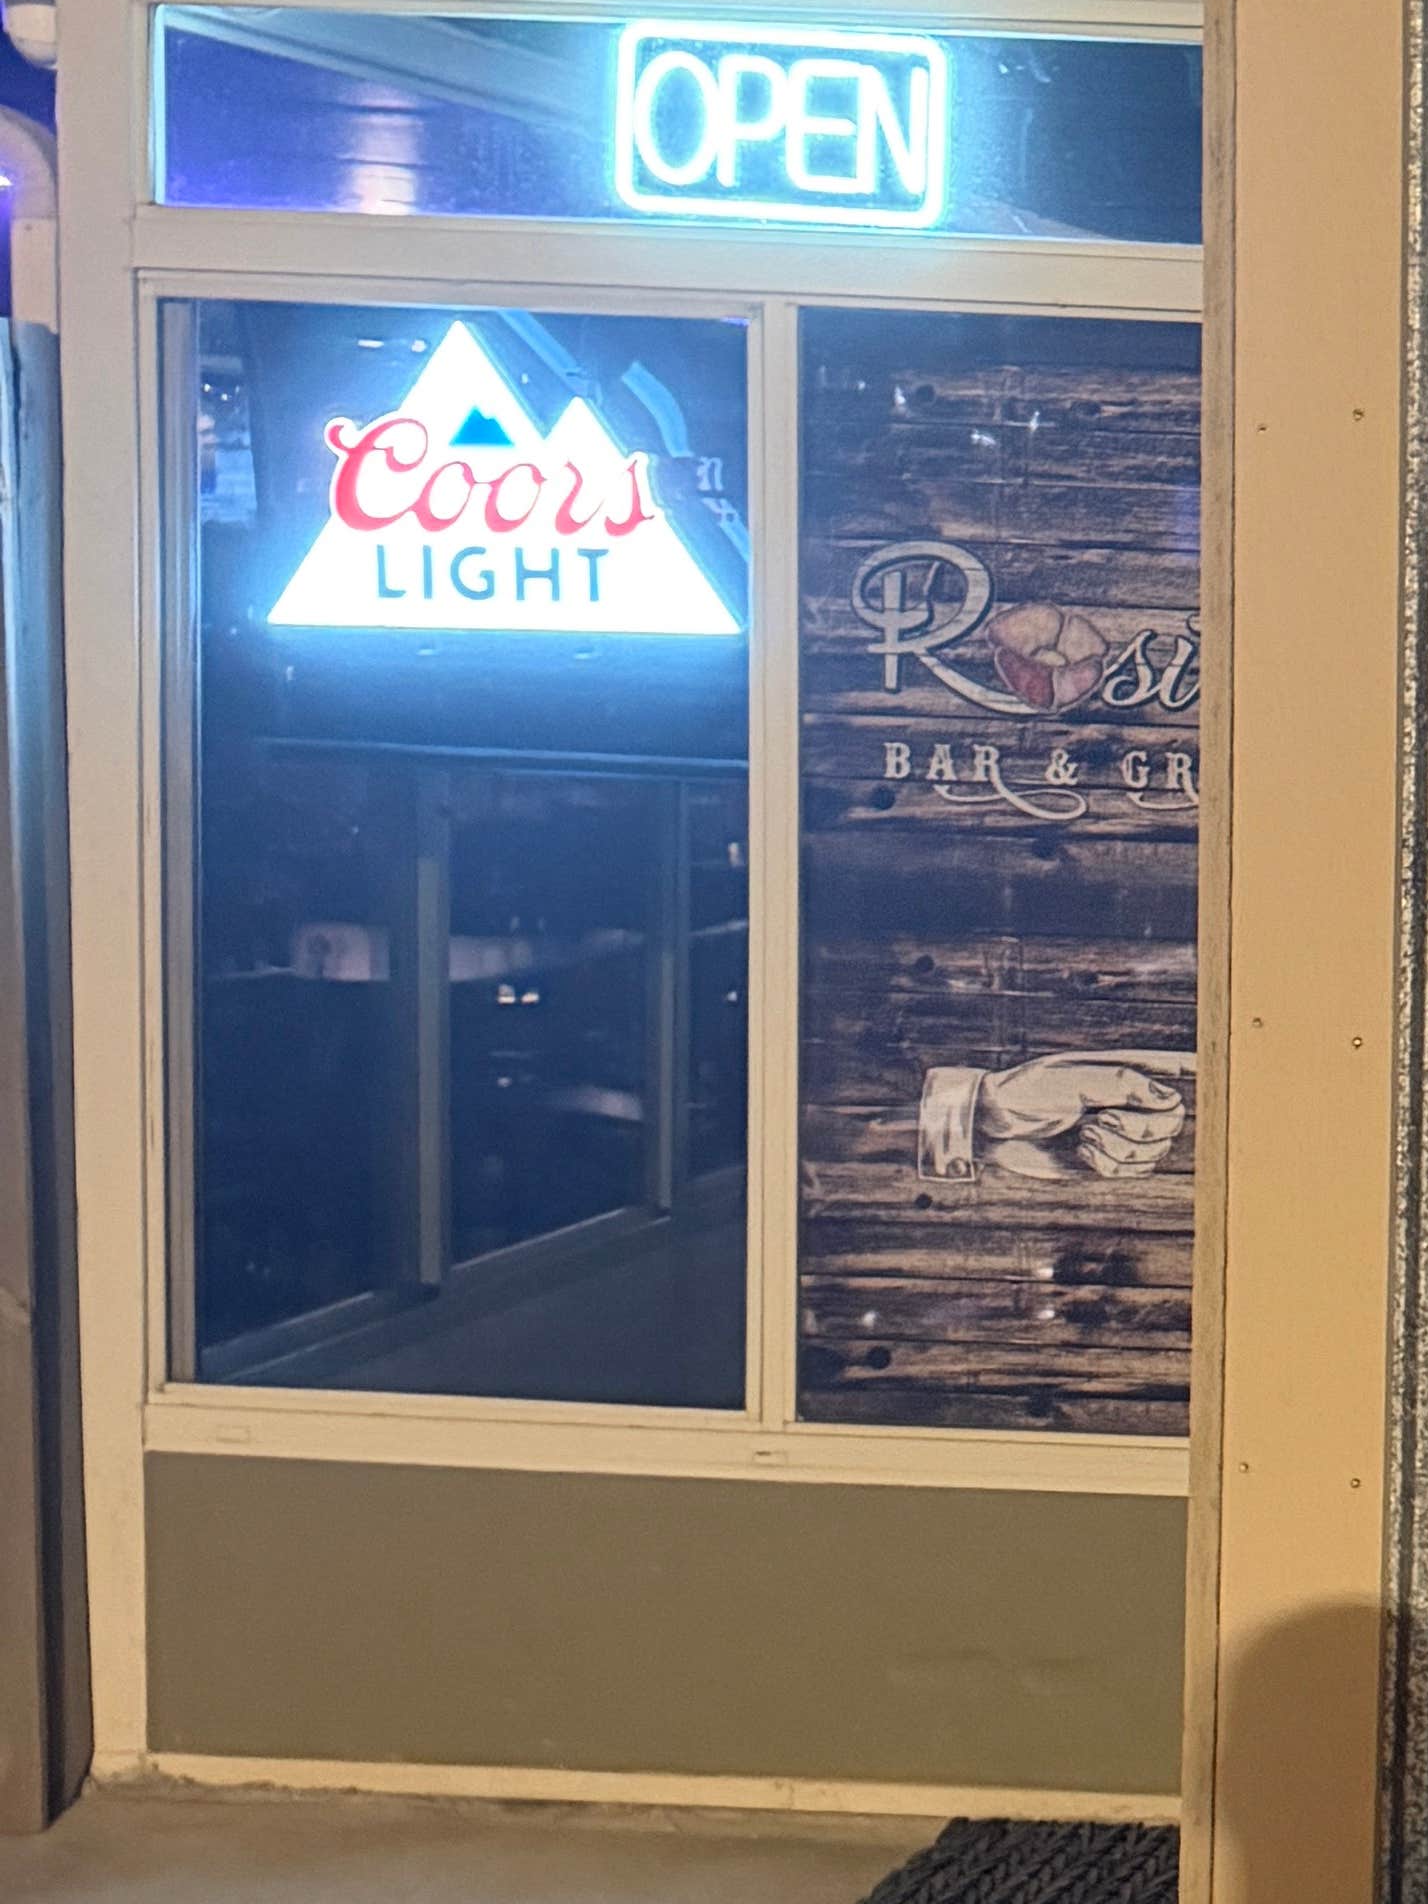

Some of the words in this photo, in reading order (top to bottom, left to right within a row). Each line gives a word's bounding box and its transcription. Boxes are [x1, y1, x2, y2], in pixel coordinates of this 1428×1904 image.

[633, 51, 929, 195] OPEN
[328, 417, 656, 537] Coors
[375, 544, 610, 602] LIGHT
[883, 741, 1088, 820] BAR
[1044, 748, 1079, 786] &
